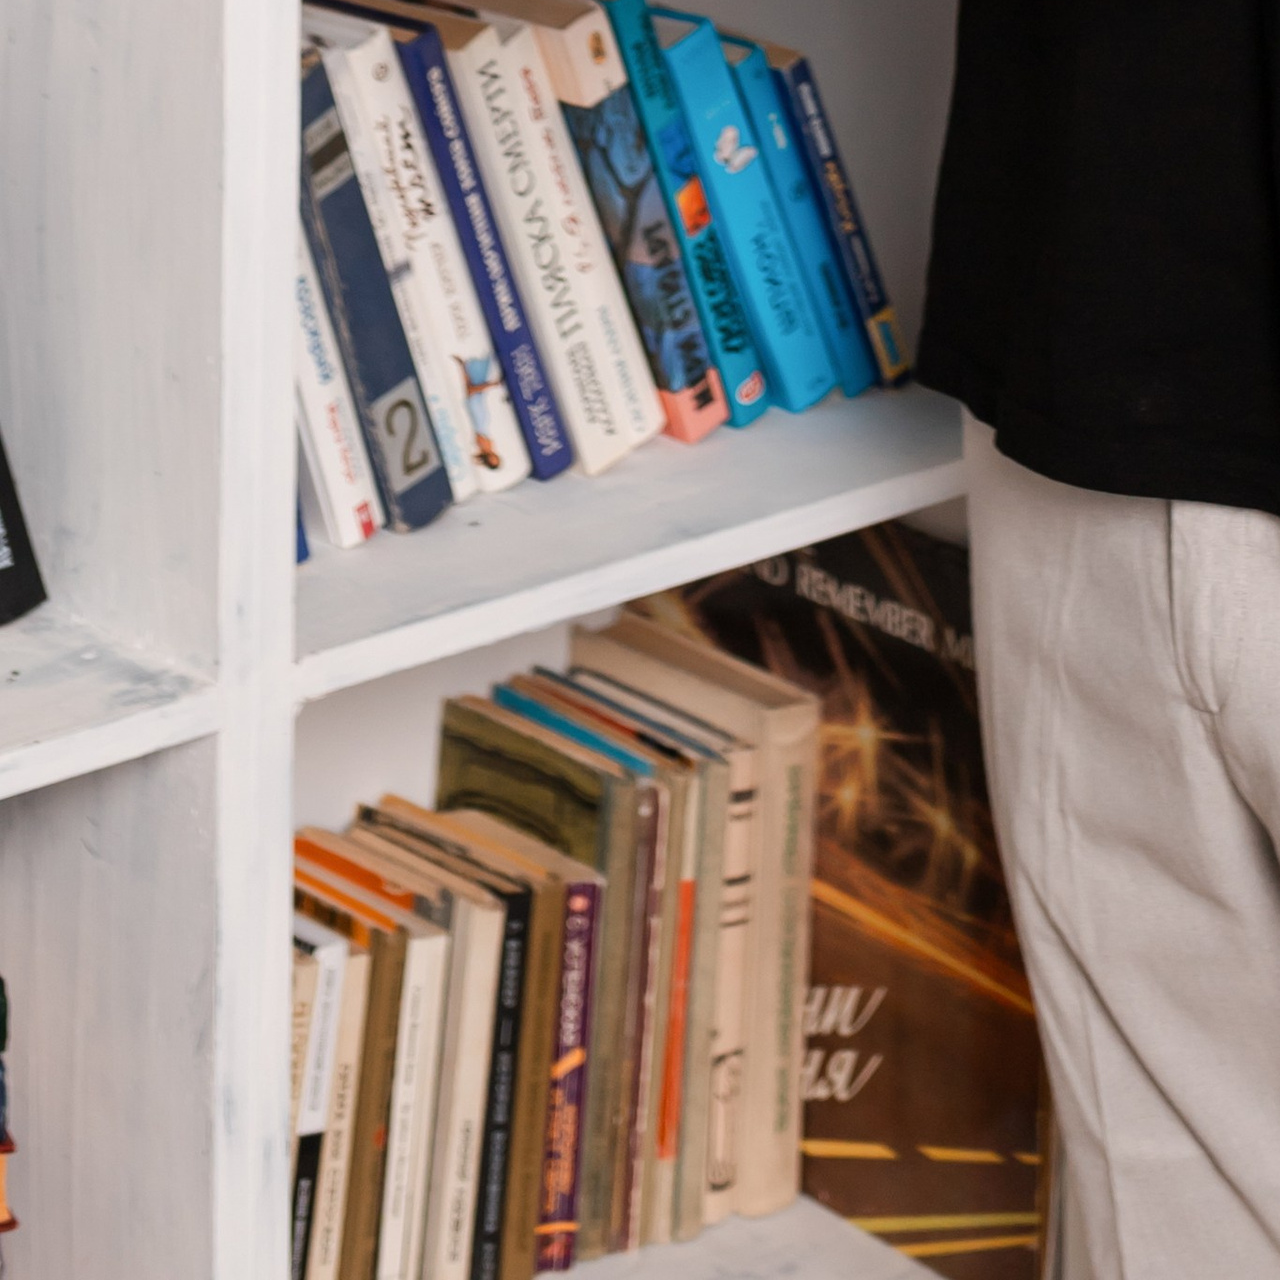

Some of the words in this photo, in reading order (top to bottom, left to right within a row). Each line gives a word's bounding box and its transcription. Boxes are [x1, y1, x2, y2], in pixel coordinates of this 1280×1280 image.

[468, 56, 542, 202] СМЕРТИ
[516, 197, 587, 341] ПЛЯСКА
[384, 397, 431, 476] 2
[796, 562, 935, 651] REMEMBER
